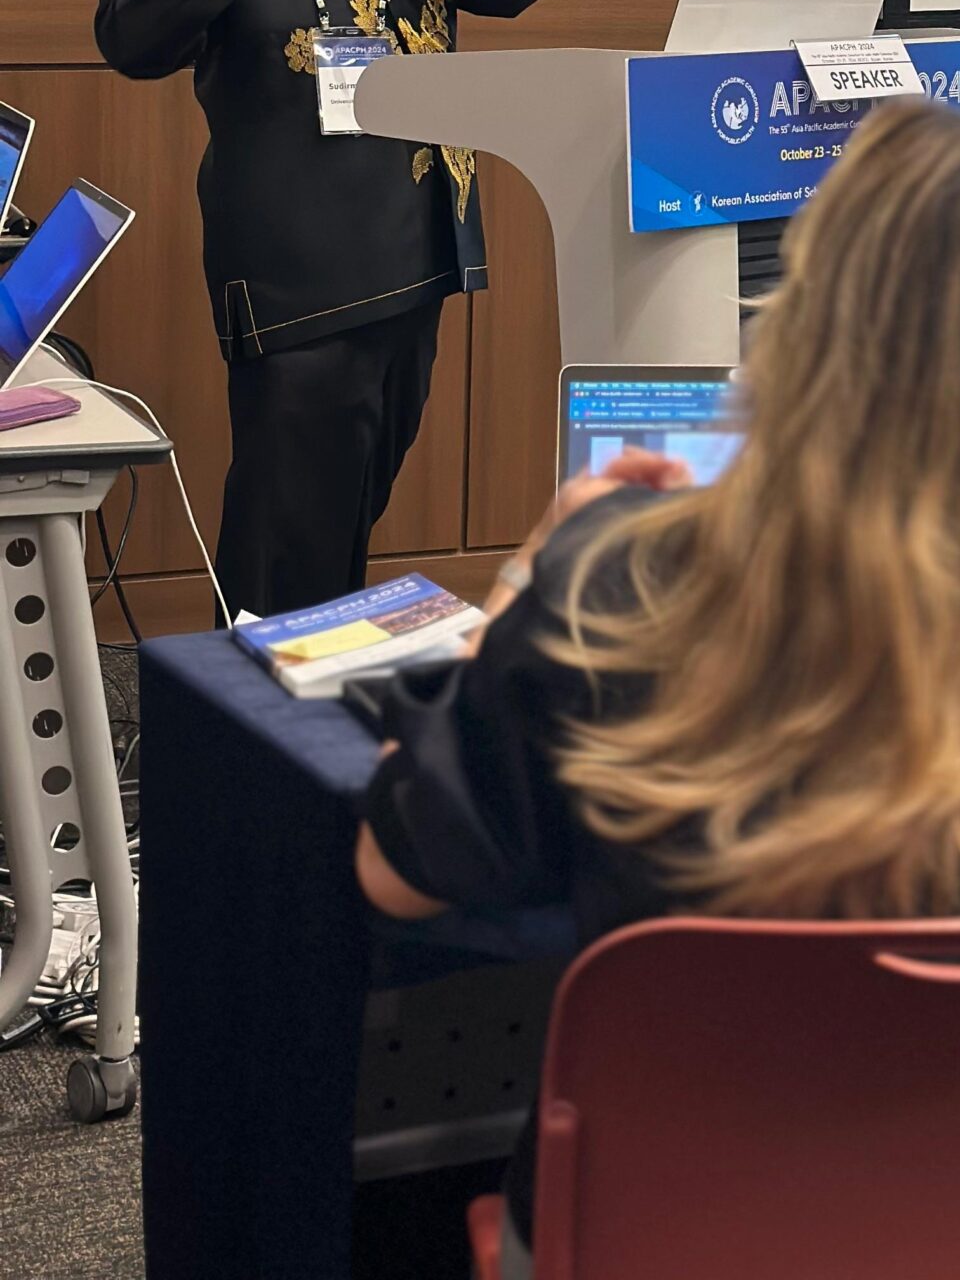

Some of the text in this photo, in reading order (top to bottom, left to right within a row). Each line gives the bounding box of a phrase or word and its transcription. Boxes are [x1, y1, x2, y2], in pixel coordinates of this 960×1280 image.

[335, 46, 387, 54] APACPH 2024
[830, 42, 875, 51] APACPH 2024
[829, 69, 904, 90] SPEAKER
[768, 126, 780, 135] The
[791, 124, 804, 133] Asia
[804, 122, 823, 132] Pacific
[823, 121, 849, 130] Academic
[780, 147, 813, 161] October
[814, 145, 824, 158] 23
[711, 195, 742, 208] Korean
[744, 189, 792, 204] Association
[793, 187, 802, 199] of
[659, 199, 681, 213] Host
[367, 580, 418, 603] 2024
